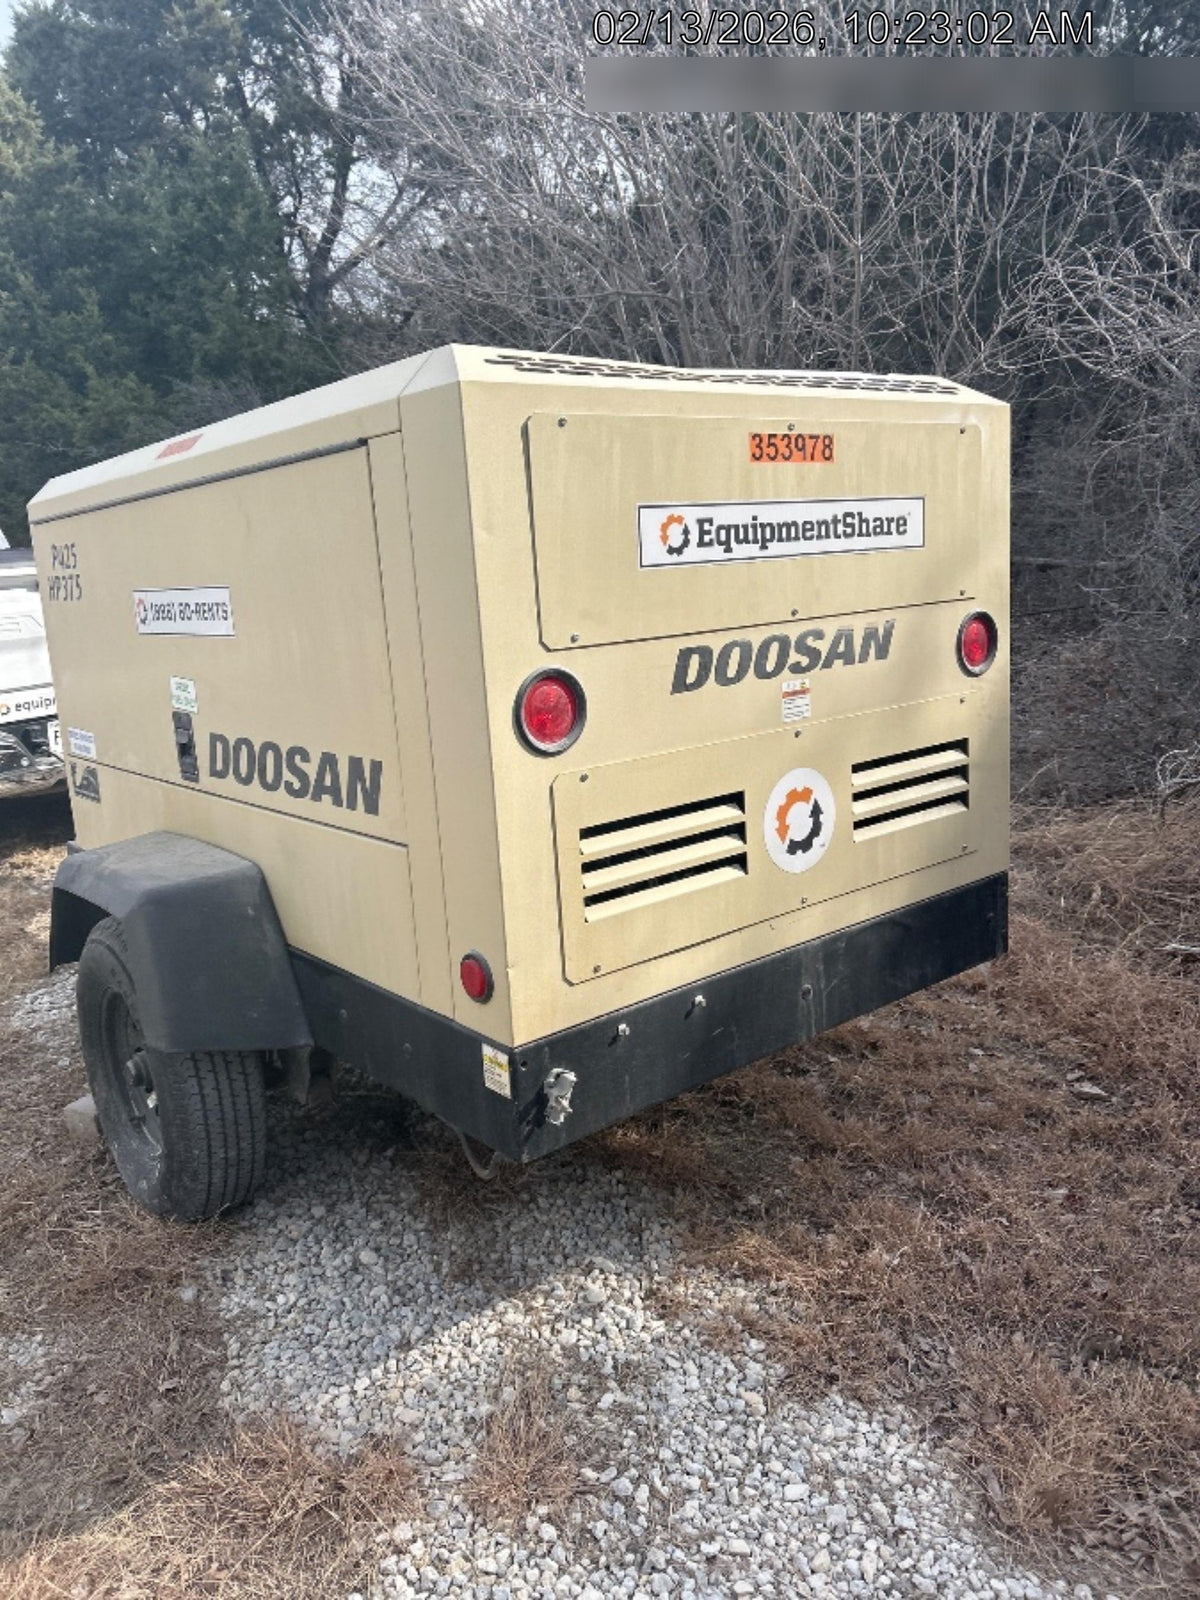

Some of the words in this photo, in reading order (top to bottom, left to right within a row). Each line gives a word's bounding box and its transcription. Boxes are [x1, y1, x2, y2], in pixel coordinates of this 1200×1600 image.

[751, 433, 833, 461] 353978
[696, 511, 909, 553] EquipmentShare
[670, 618, 896, 695] DOOSAN
[208, 732, 383, 816] DOOSAN
